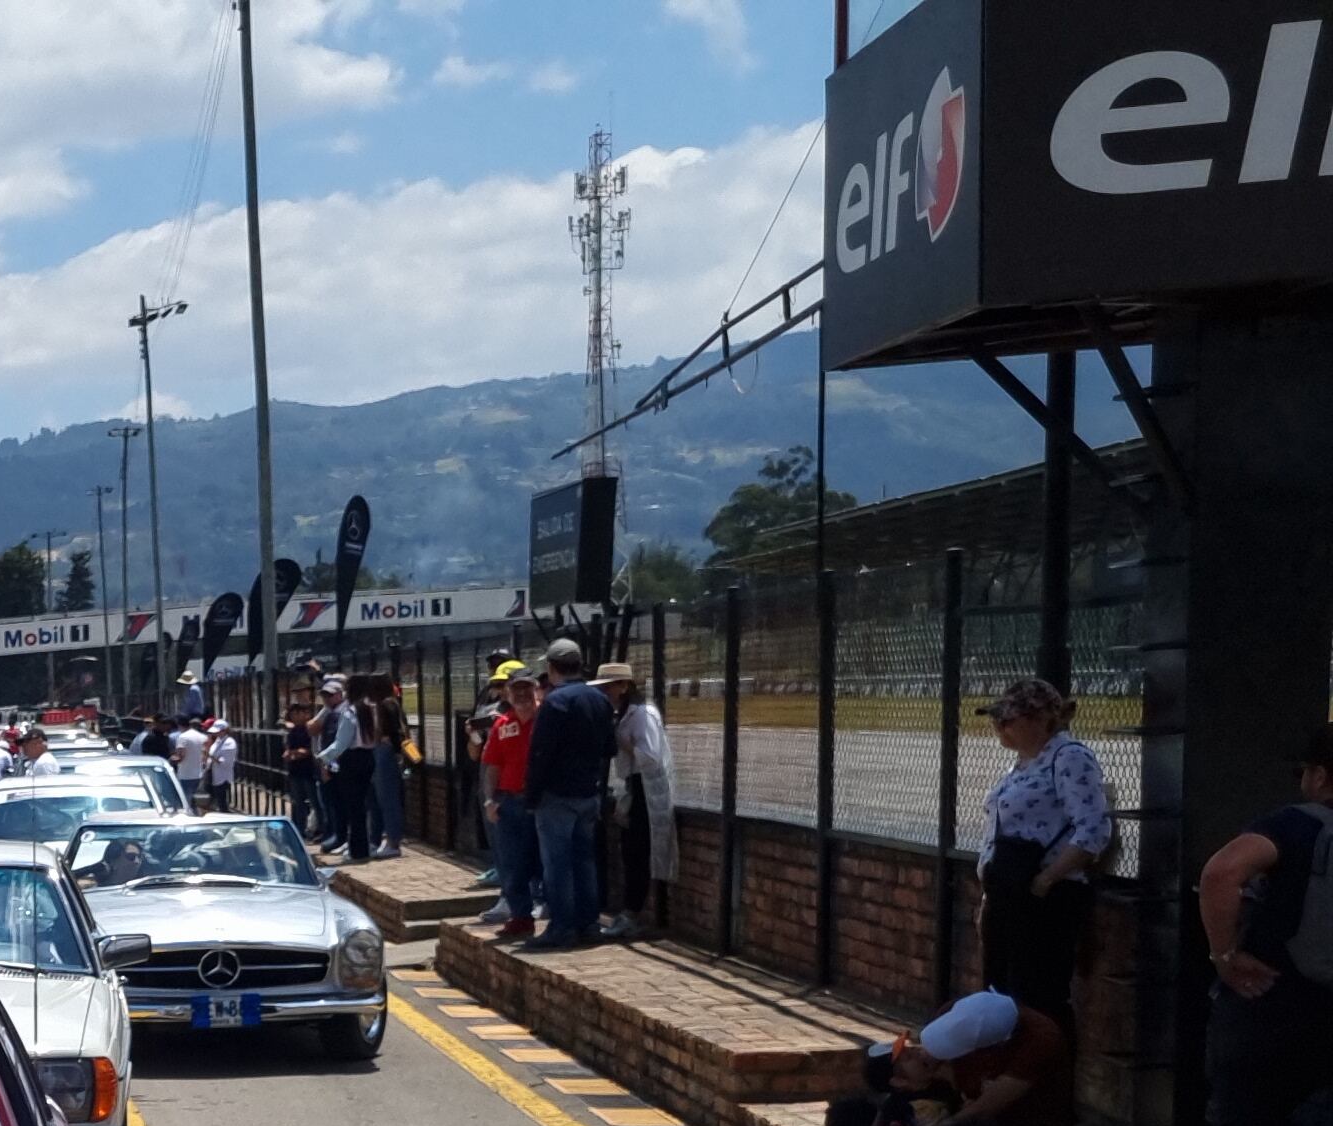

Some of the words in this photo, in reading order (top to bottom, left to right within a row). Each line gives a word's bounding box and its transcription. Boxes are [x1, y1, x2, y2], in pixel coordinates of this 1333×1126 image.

[1050, 19, 1333, 195] el
[835, 112, 914, 274] elf
[4, 626, 65, 649] Mobil
[361, 600, 425, 621] Mobil
